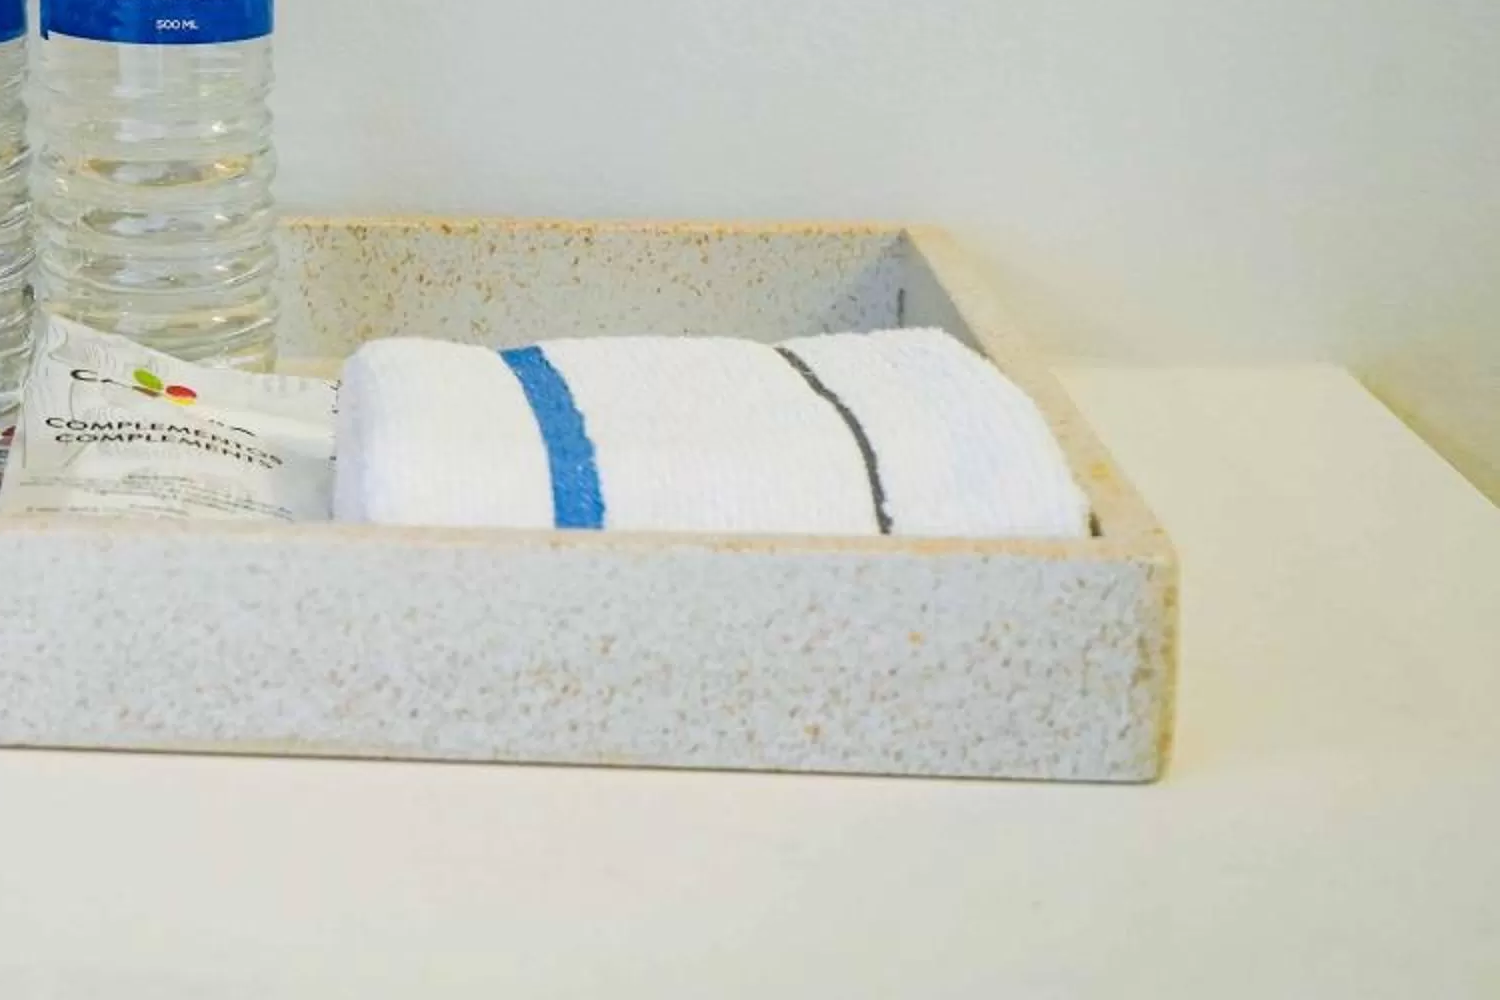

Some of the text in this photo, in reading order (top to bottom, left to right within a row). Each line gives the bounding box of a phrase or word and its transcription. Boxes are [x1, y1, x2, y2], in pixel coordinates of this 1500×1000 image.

[155, 19, 181, 30] 500
[45, 416, 283, 465] COMPLEMENTOS
[55, 432, 273, 469] COMPLEMENTS
